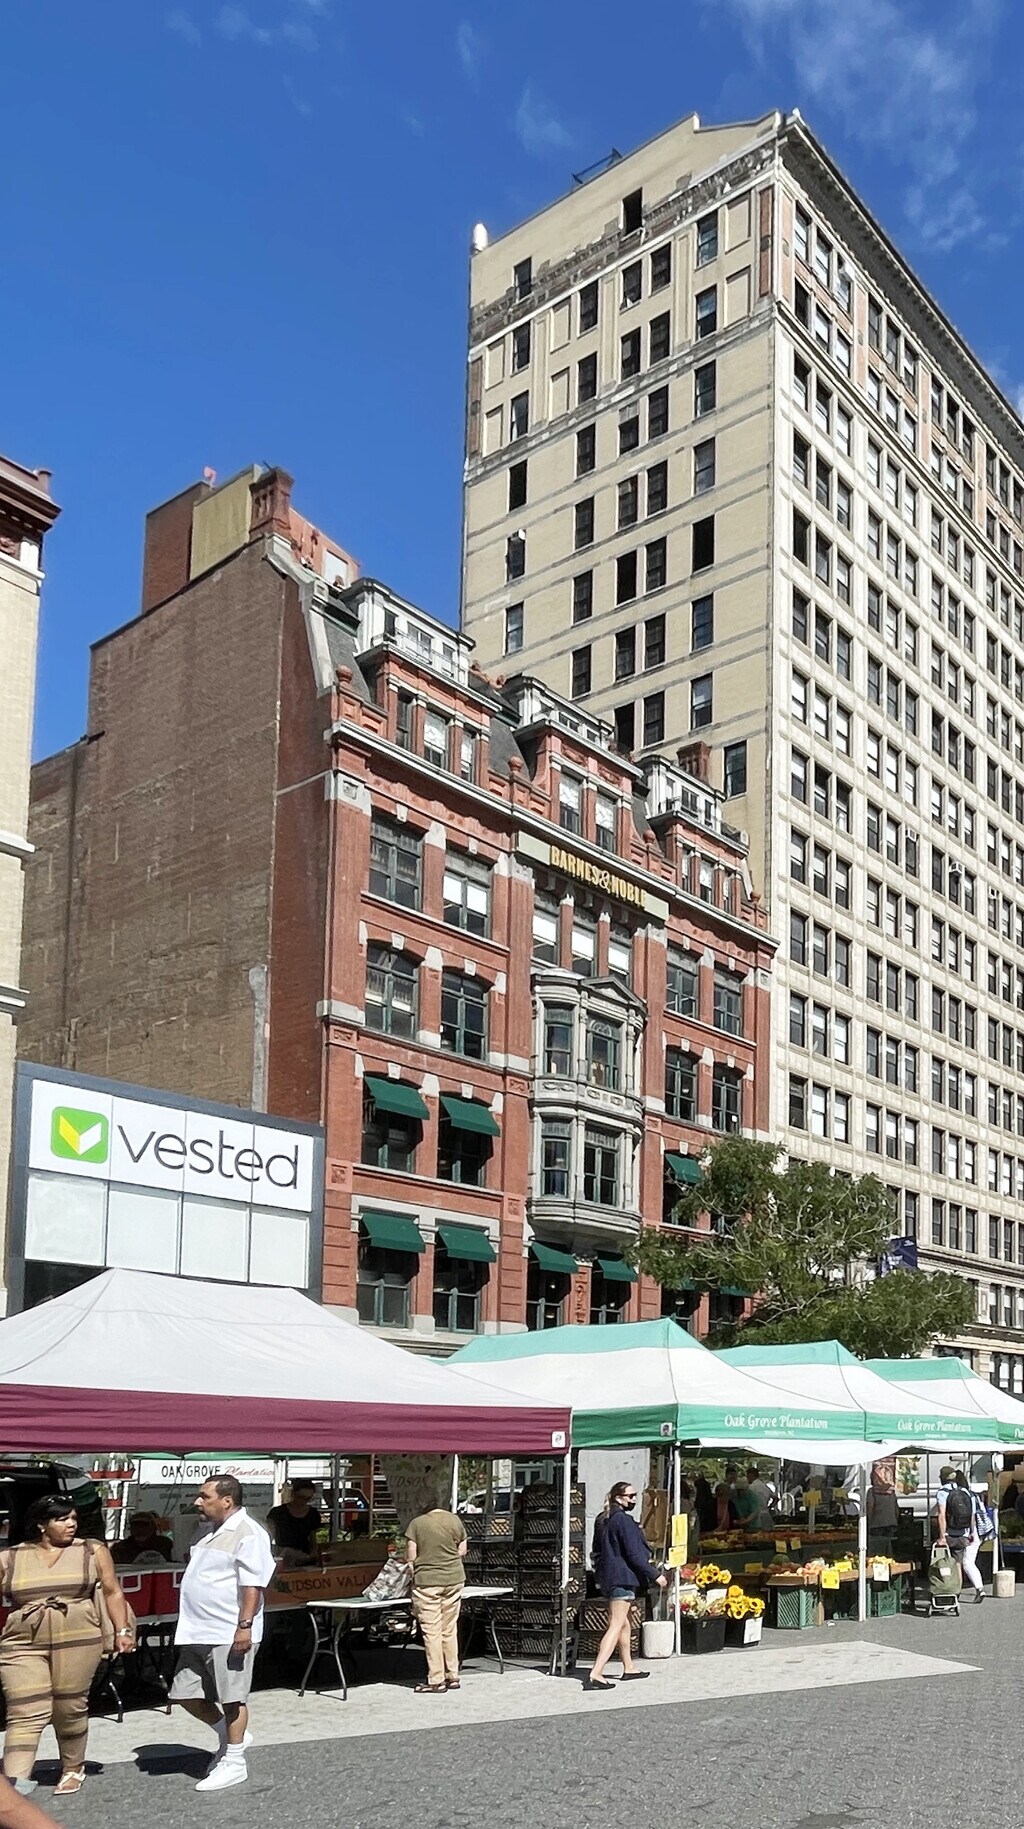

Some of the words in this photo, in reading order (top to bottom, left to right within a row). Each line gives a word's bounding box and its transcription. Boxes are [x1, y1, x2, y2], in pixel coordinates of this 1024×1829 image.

[117, 1123, 299, 1189] vested
[724, 1412, 746, 1428] Oak
[747, 1414, 777, 1430] Grove
[778, 1413, 828, 1429] Plantation
[897, 1417, 913, 1431] Oak
[914, 1419, 935, 1433] Grove
[161, 1465, 183, 1478] OAK
[186, 1464, 221, 1478] GROVE
[276, 1578, 331, 1594] UDSON
[336, 1574, 373, 1588] VALL
